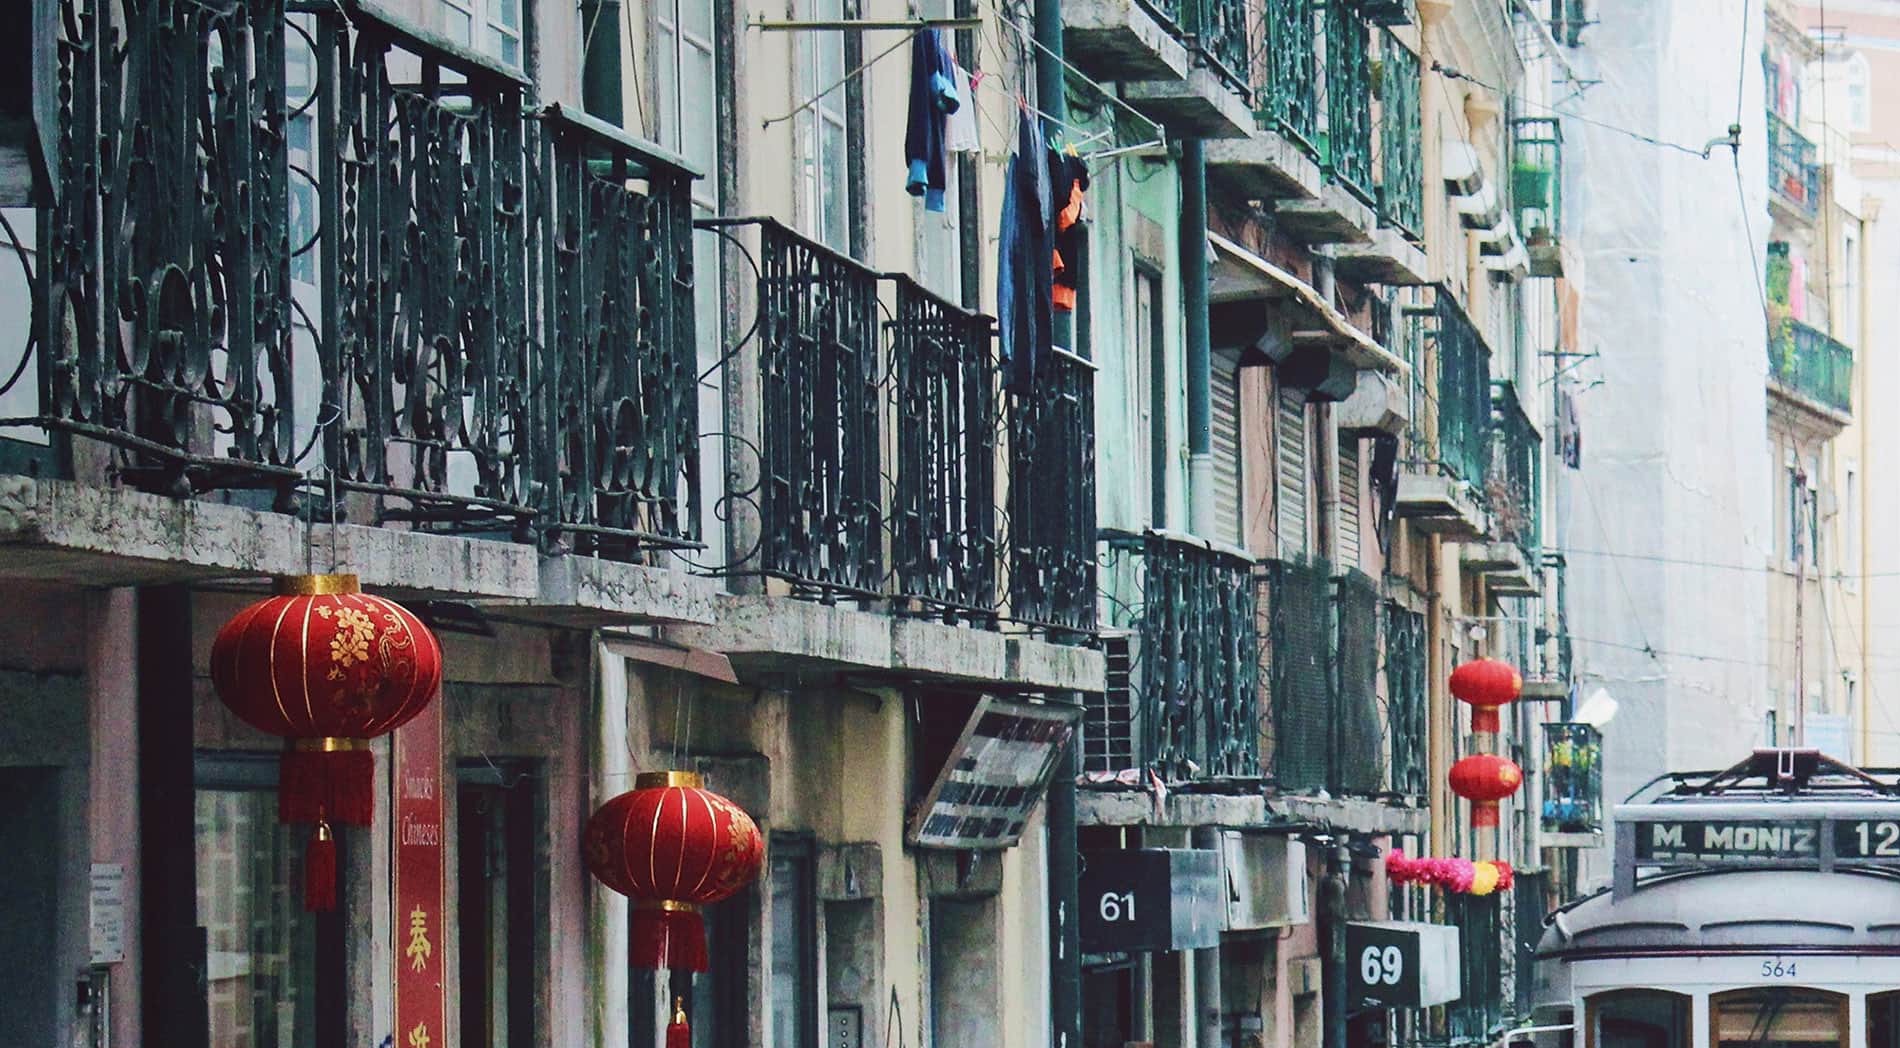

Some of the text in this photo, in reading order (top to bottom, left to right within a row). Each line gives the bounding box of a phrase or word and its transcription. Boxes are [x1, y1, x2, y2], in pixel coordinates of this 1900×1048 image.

[402, 811, 440, 846] Chineses
[1652, 823, 1817, 852] M. MONIZ
[1855, 821, 1900, 856] 12
[1100, 891, 1136, 922] 61
[1361, 945, 1403, 986] 69
[1761, 960, 1796, 977] 564
